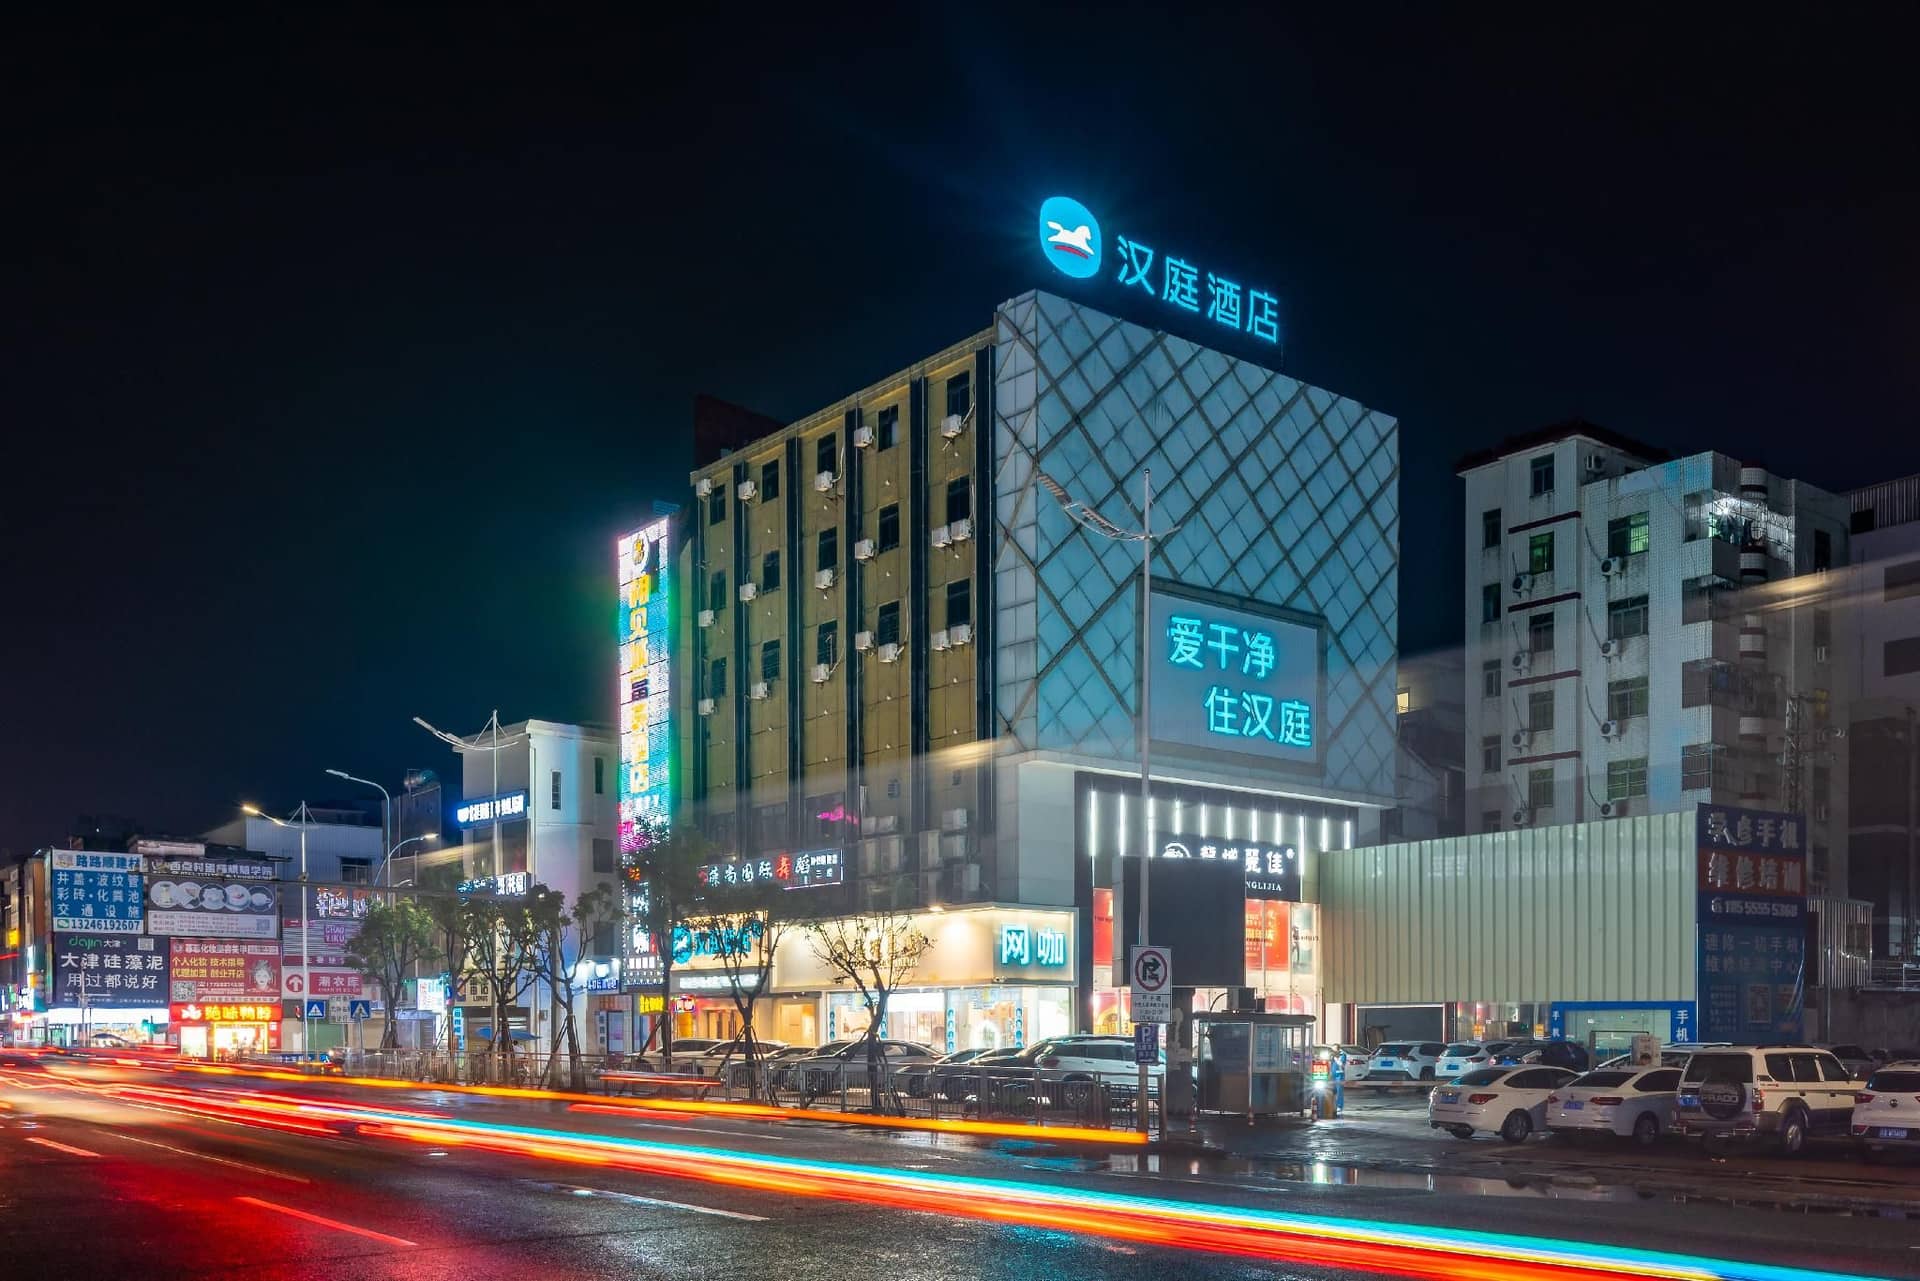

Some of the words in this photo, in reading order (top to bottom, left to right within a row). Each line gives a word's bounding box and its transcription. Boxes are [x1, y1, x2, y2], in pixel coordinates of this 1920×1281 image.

[1117, 235, 1278, 344] 汉庭酒店
[1167, 616, 1274, 679] 爱干净
[1204, 687, 1311, 747] 住汉庭
[57, 904, 140, 919] 交通设施
[72, 920, 140, 930] 13246192607
[69, 936, 102, 950] dajin
[1001, 924, 1064, 966] 网咖
[61, 952, 165, 971] 大津硅藻泥
[172, 957, 206, 967] 个人化妆
[67, 973, 158, 989] 用过都说好
[318, 976, 360, 988] 潮衣库
[1676, 1010, 1689, 1042] 手机
